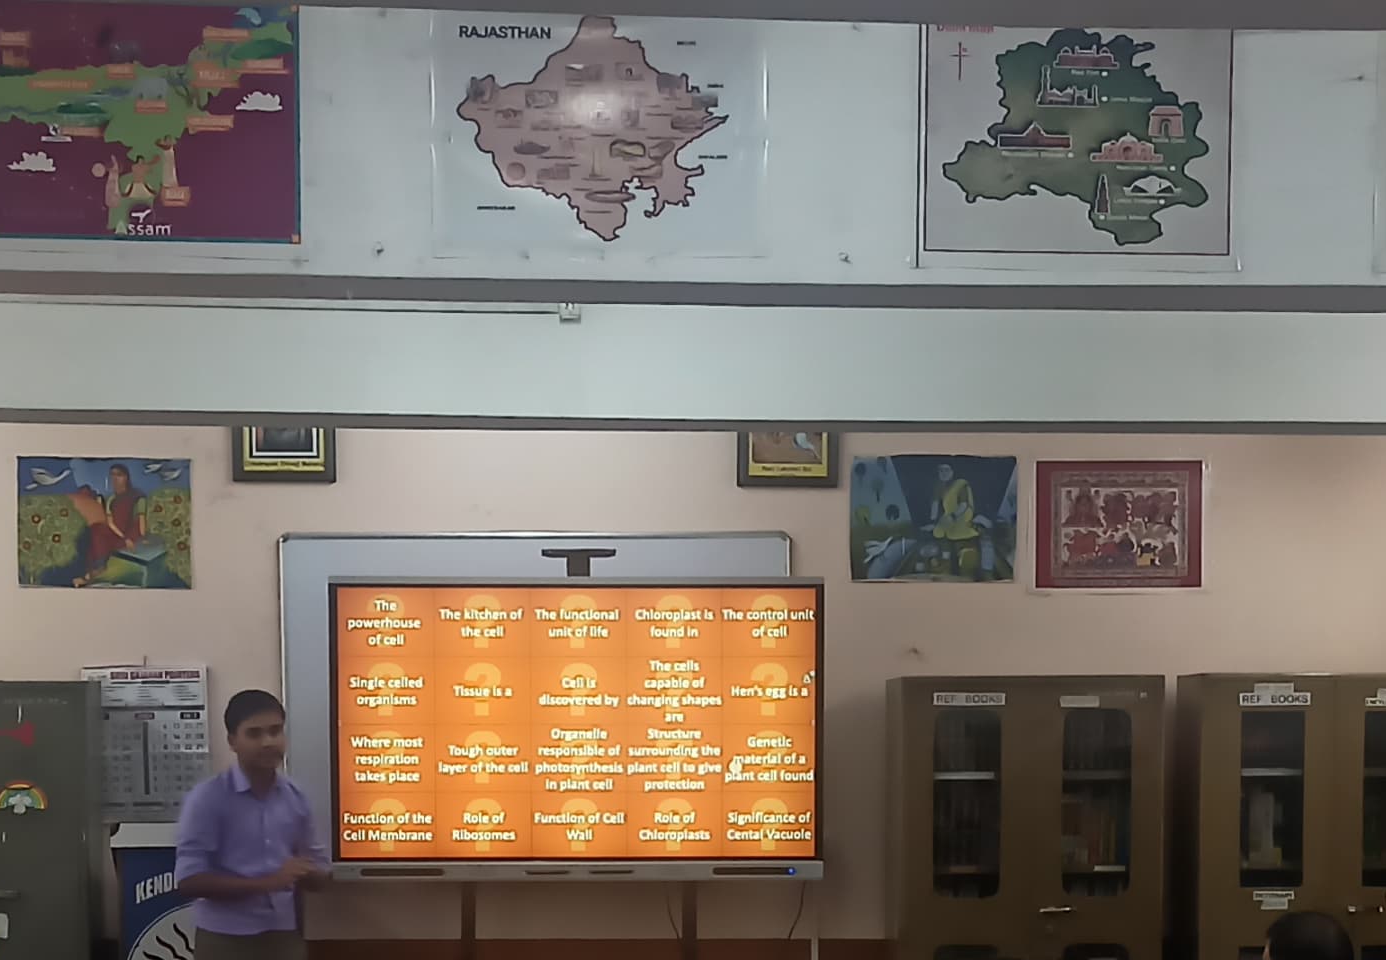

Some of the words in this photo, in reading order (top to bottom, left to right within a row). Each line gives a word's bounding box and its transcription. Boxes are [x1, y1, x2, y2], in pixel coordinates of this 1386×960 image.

[458, 25, 551, 40] RAJASTHAN
[115, 221, 172, 236] Assam
[373, 599, 397, 612] The
[439, 608, 461, 620] The
[464, 608, 507, 620] kitchen
[509, 608, 523, 620] of
[535, 608, 557, 620] The
[559, 608, 619, 620] functional
[635, 608, 702, 623] Chloroplast
[704, 608, 714, 620] is
[721, 608, 744, 620] The
[746, 608, 788, 620] control
[790, 608, 815, 620] unit
[347, 617, 421, 631] powerhouse
[461, 625, 481, 637] the
[483, 625, 504, 637] cell
[548, 625, 572, 637] unit
[574, 625, 587, 637] of
[590, 625, 609, 637] life
[650, 625, 684, 637] found
[687, 625, 699, 637] in
[751, 625, 765, 637] of
[767, 625, 788, 637] cell
[368, 634, 381, 646] of
[383, 634, 405, 646] cell
[649, 660, 671, 672] The
[673, 660, 700, 672] cells
[349, 676, 385, 690] Single
[387, 676, 424, 688] celled
[561, 677, 584, 689] Cell
[586, 677, 597, 689] is
[644, 677, 690, 690] capable
[692, 677, 705, 689] of
[453, 685, 490, 697] Tissue
[493, 685, 502, 697] is
[504, 688, 512, 697] a
[731, 685, 763, 697] Hen's
[764, 687, 787, 699] egg
[788, 685, 798, 697] is
[800, 688, 809, 697] a
[356, 694, 417, 707] organisms
[539, 694, 602, 706] discovered
[604, 694, 619, 707] by
[627, 694, 679, 707] changing
[681, 694, 722, 707] shapes
[1242, 694, 1261, 704] REF
[1271, 694, 1309, 704] BOOKS
[664, 712, 684, 722] are
[551, 728, 608, 741] Organelle
[647, 728, 702, 740] Structure
[350, 736, 391, 748] Where
[393, 736, 423, 748] most
[747, 736, 793, 747] Genetic
[448, 745, 483, 758] Tough
[485, 747, 519, 757] outer
[538, 745, 605, 758] responsible
[607, 745, 621, 757] of
[628, 745, 699, 758] surrounding
[701, 745, 721, 757] the
[355, 753, 419, 767] respiration
[733, 752, 782, 764] material
[783, 752, 797, 764] of
[798, 755, 806, 764] a
[438, 762, 468, 775] layer
[470, 762, 484, 773] of
[485, 762, 505, 773] the
[507, 762, 529, 773] cell
[535, 762, 623, 775] photosynthesis
[627, 762, 658, 775] plant
[660, 762, 680, 773] cell
[683, 762, 696, 773] to
[697, 762, 722, 775] give
[355, 771, 386, 782] takes
[388, 771, 420, 784] place
[757, 769, 777, 781] cell
[780, 769, 815, 781] found
[545, 779, 557, 790] in
[559, 779, 590, 792] plant
[592, 779, 613, 790] cell
[644, 779, 705, 792] protection
[343, 812, 394, 824] Function
[396, 812, 411, 824] of
[412, 812, 432, 824] the
[463, 812, 490, 824] Role
[491, 812, 505, 824] of
[534, 812, 585, 824] Function
[587, 812, 601, 824] of
[602, 812, 625, 824] Cell
[654, 812, 680, 824] Role
[682, 812, 696, 824] of
[727, 811, 796, 826] Significance
[797, 811, 811, 823] of
[343, 829, 365, 841] Cell
[368, 829, 433, 841] Membrane
[452, 829, 515, 841] Ribosomes
[566, 829, 593, 841] Wall
[639, 829, 711, 843] Chloroplasts
[727, 828, 764, 840] Cental
[766, 828, 812, 840] Vacuole
[135, 871, 179, 904] KEND
